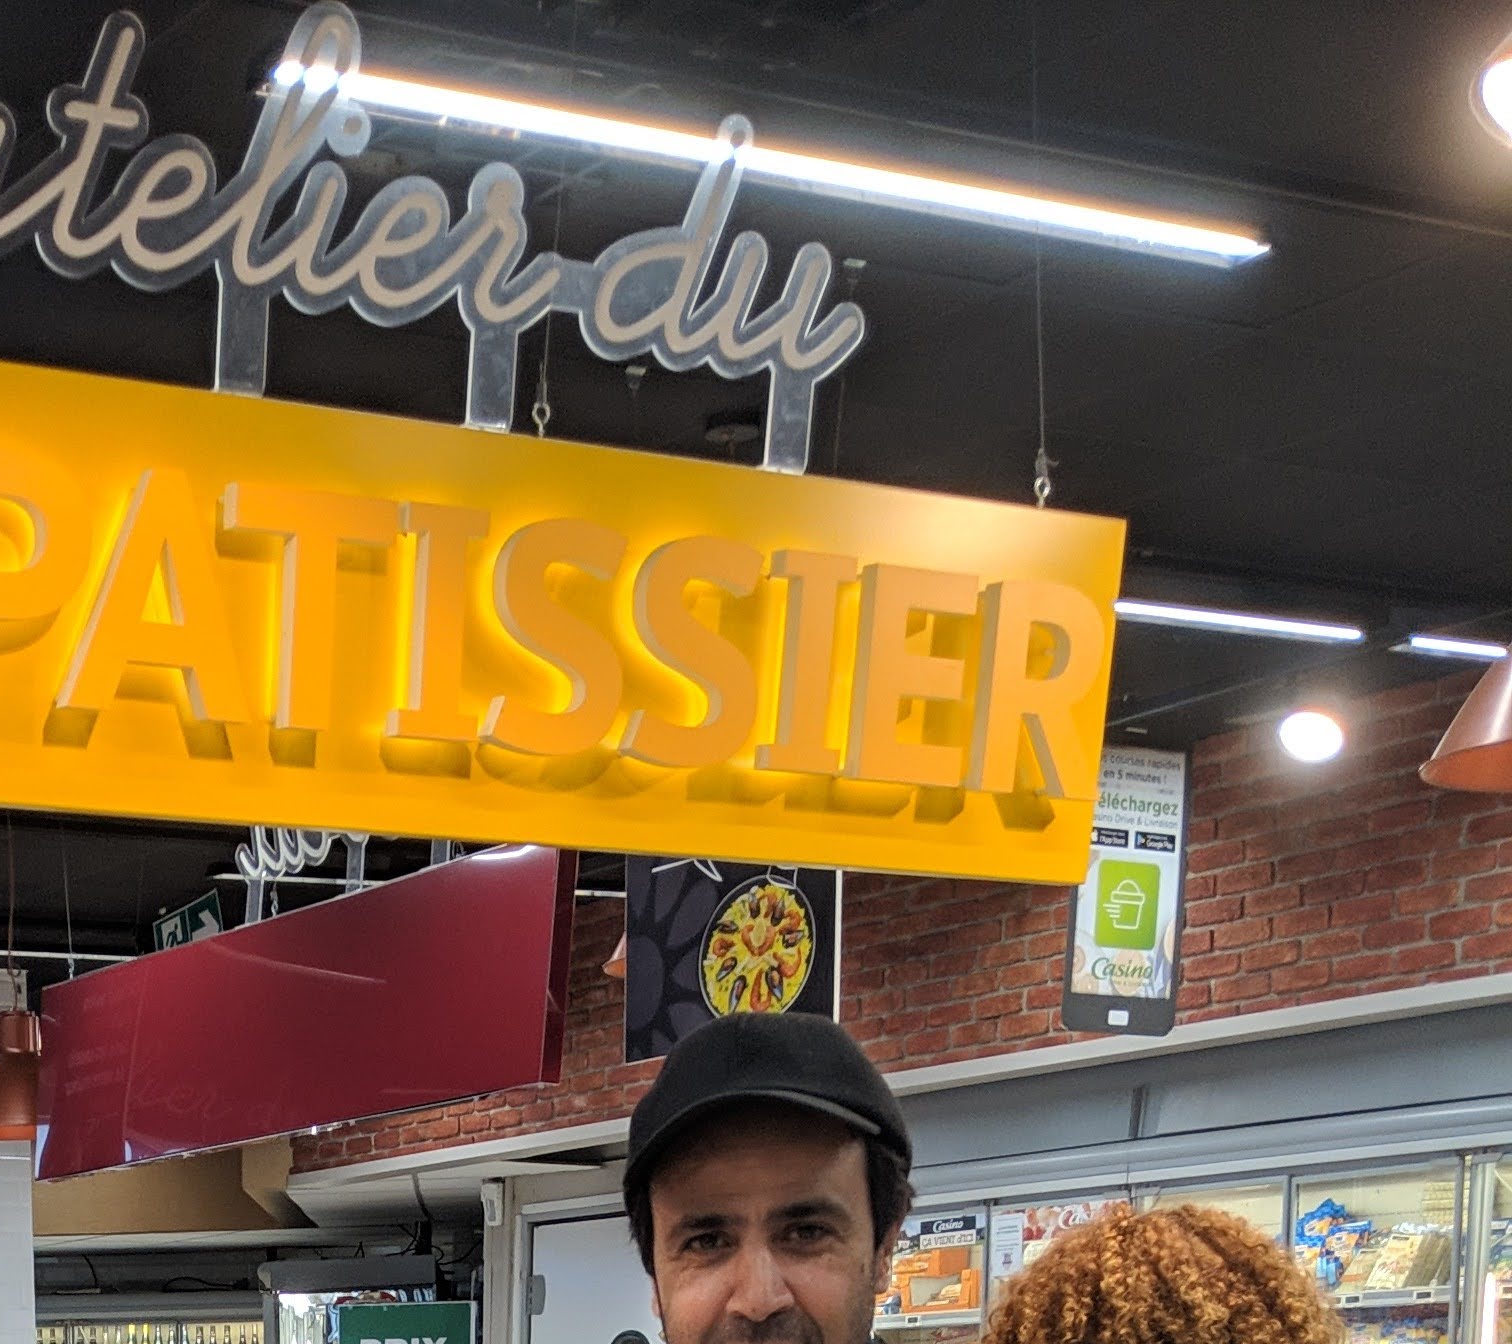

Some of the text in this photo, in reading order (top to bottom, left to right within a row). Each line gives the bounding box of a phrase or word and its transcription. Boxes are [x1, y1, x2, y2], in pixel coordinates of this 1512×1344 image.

[596, 125, 860, 368] du
[1117, 769, 1123, 780] 5
[1125, 771, 1161, 784] minutes
[1098, 792, 1179, 817] éléchargez
[1092, 957, 1154, 980] Casino
[932, 1218, 964, 1234] Casino
